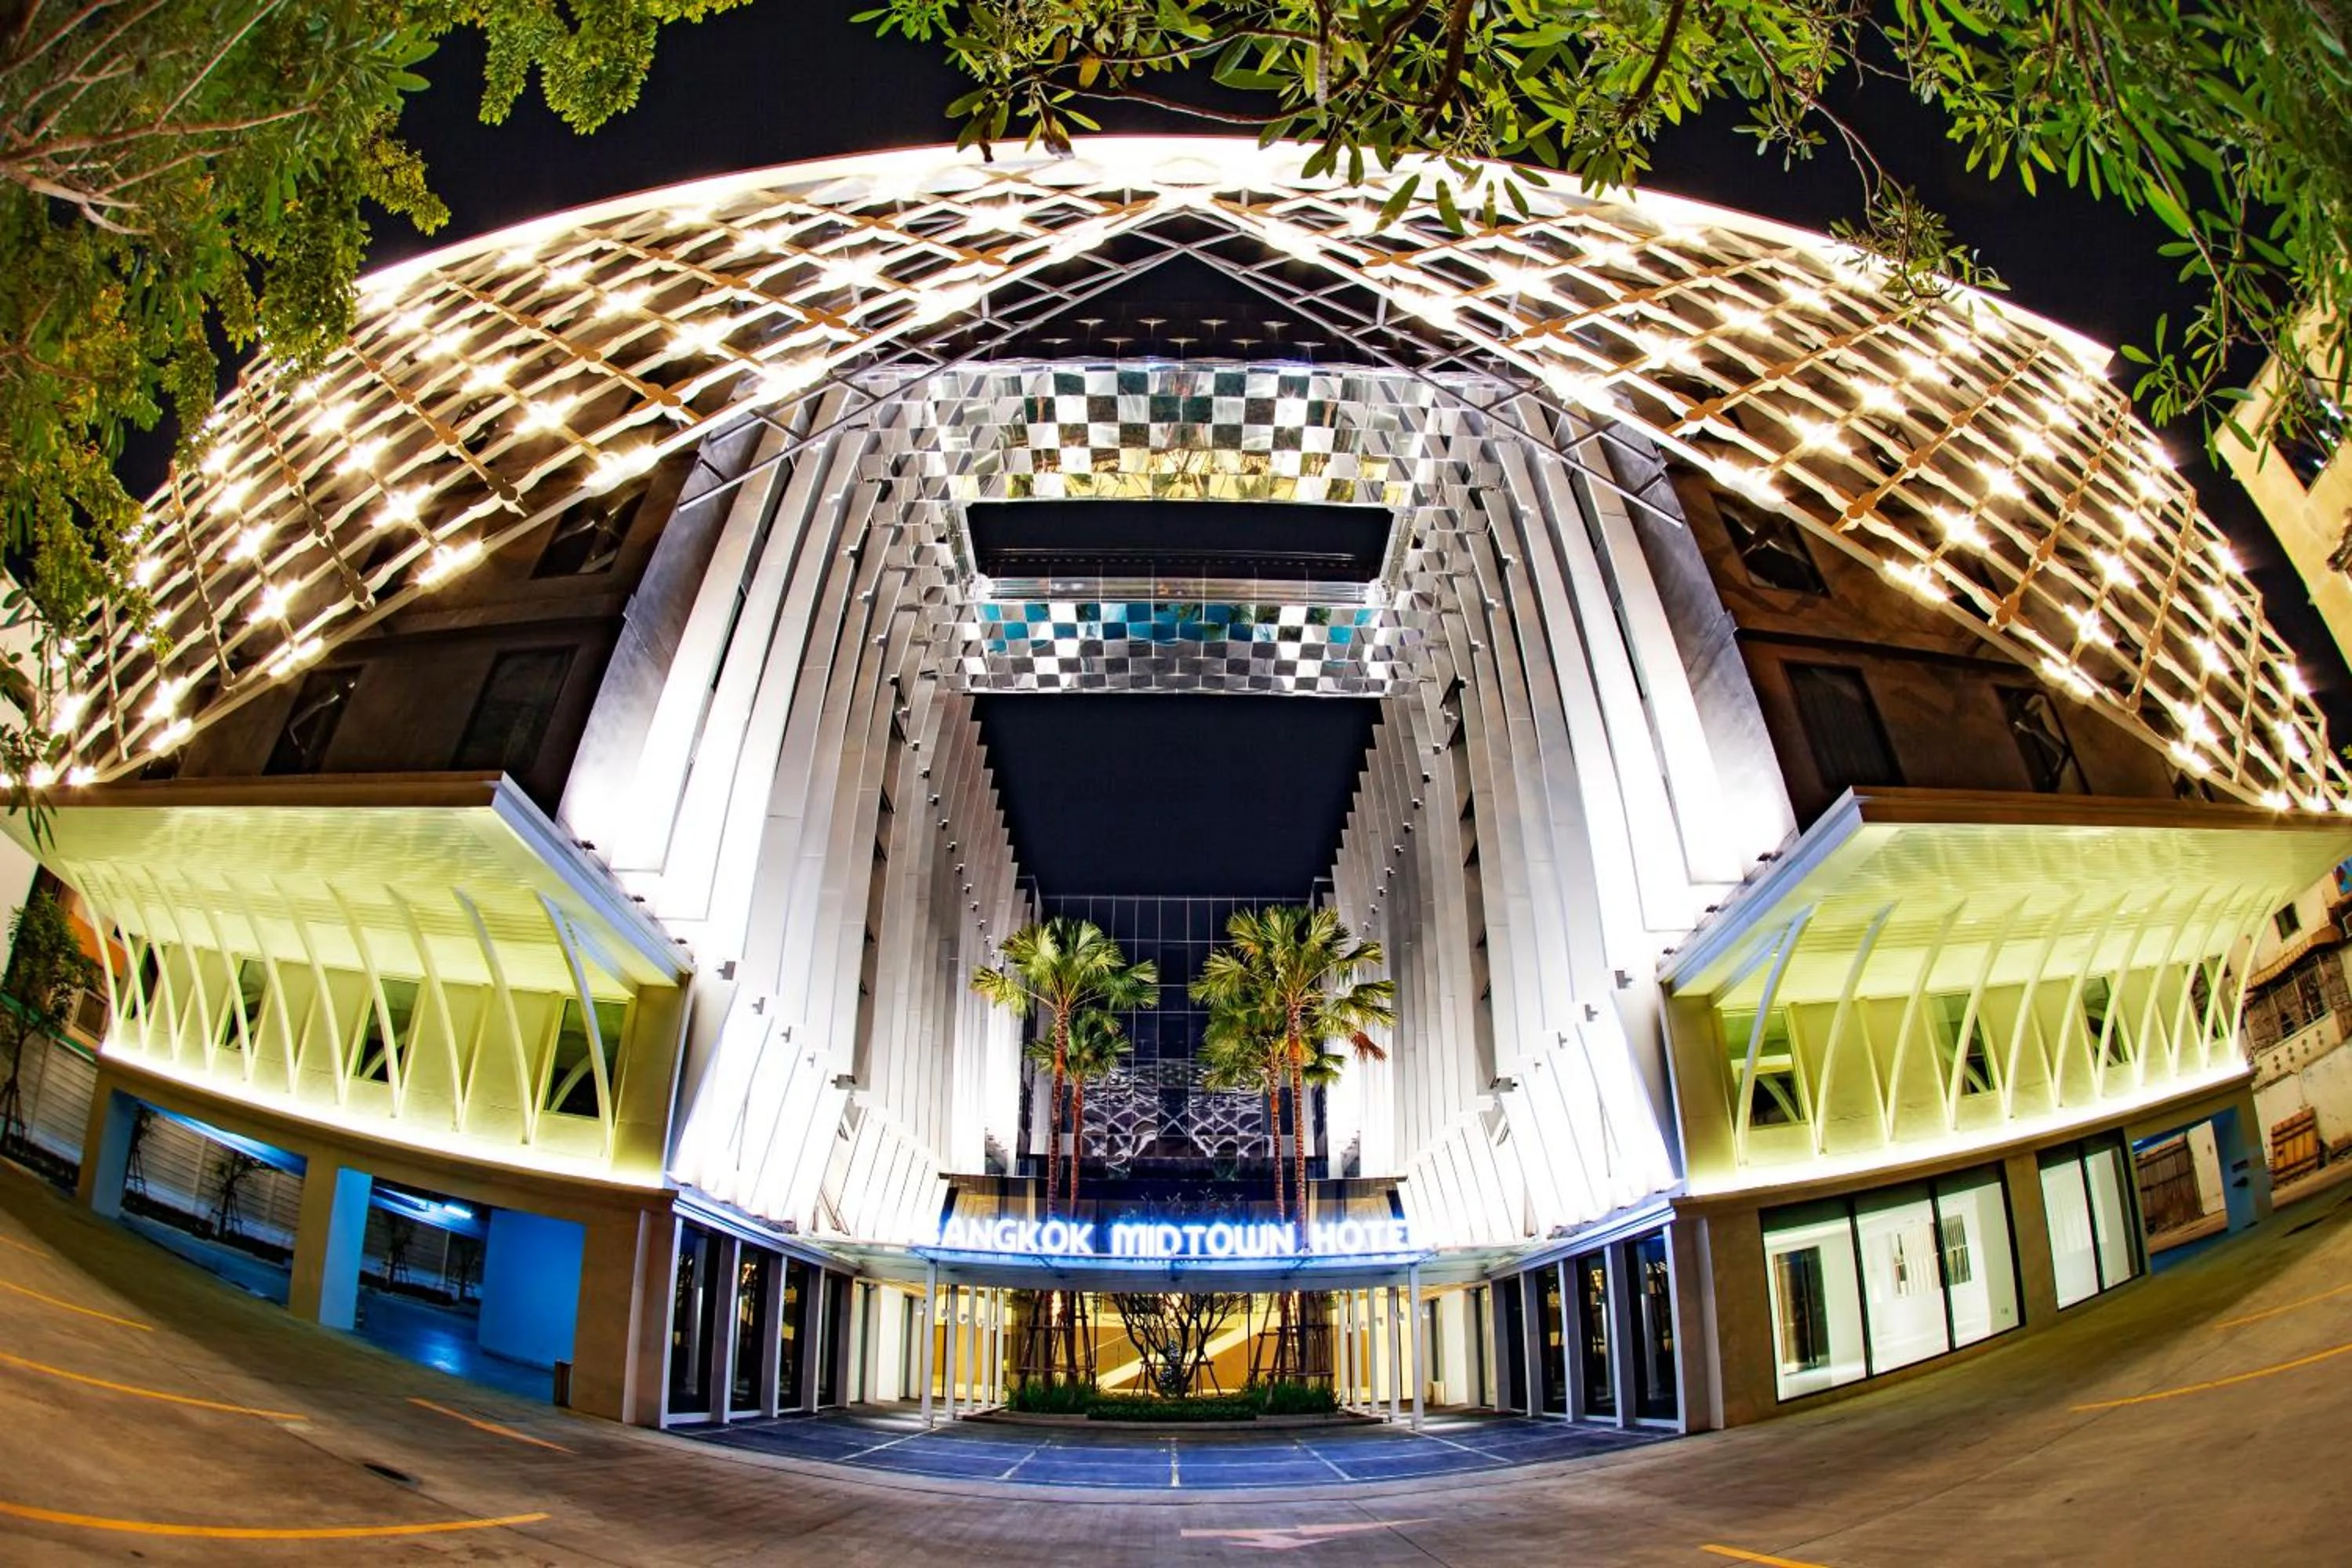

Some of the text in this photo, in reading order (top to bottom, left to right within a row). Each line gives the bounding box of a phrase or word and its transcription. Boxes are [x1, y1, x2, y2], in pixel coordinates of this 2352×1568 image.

[922, 1216, 1422, 1256] ANGKOK MIDTOWN HOTE
